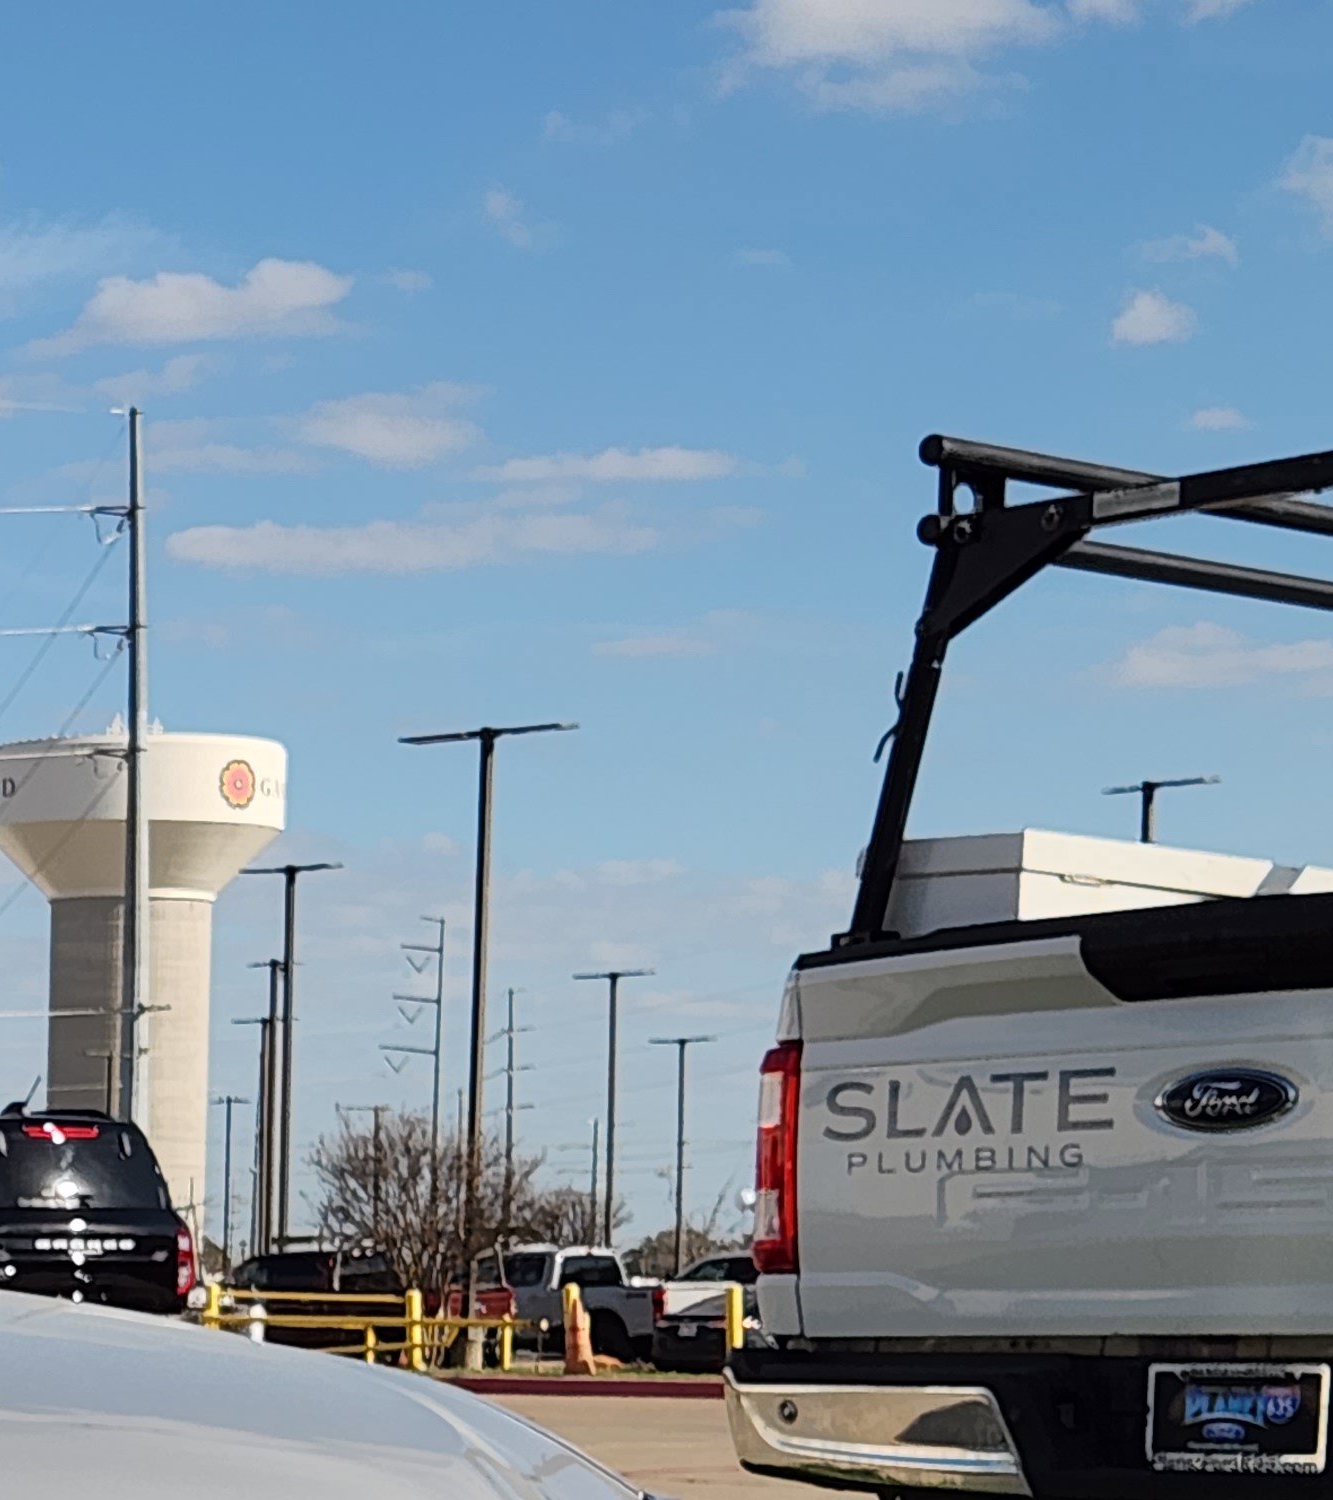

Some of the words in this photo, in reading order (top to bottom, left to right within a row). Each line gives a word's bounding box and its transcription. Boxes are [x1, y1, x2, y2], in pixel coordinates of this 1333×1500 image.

[822, 1066, 1116, 1142] SLATE
[1184, 1080, 1260, 1118] Ford
[846, 1143, 1084, 1176] PLUMBING
